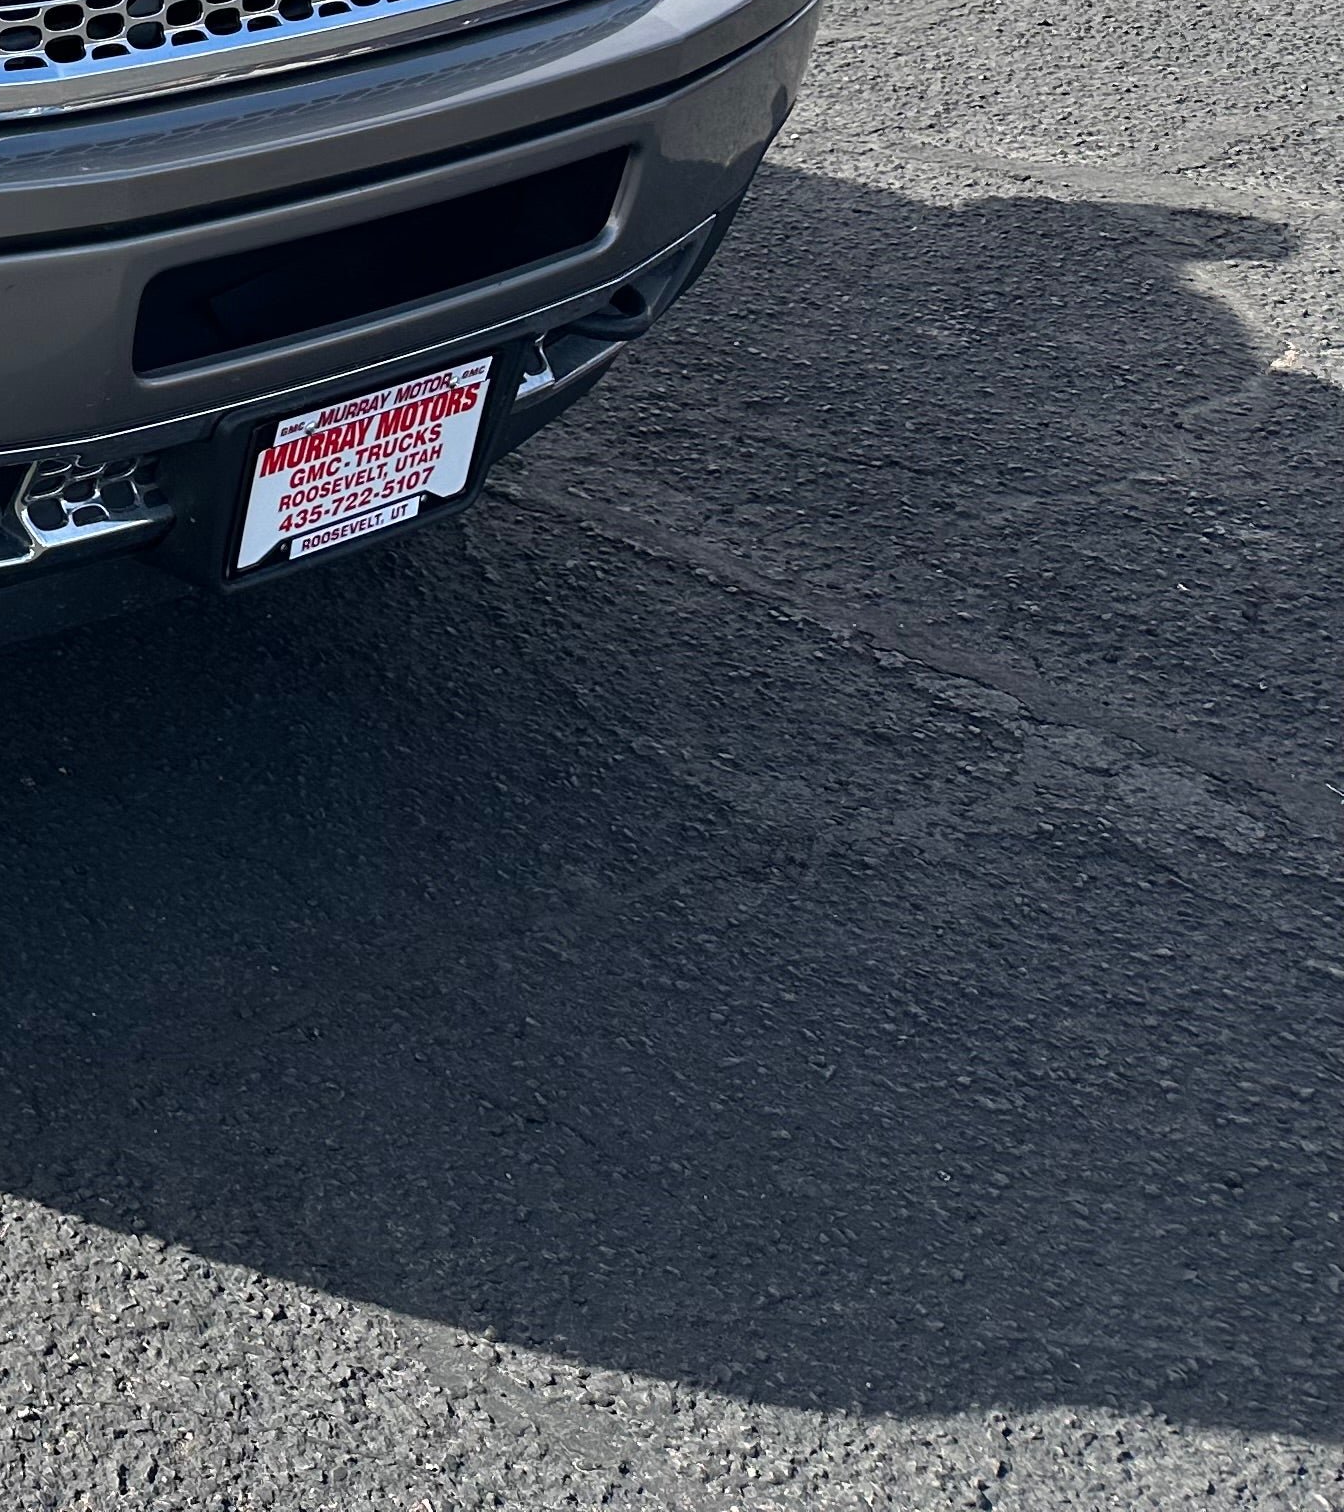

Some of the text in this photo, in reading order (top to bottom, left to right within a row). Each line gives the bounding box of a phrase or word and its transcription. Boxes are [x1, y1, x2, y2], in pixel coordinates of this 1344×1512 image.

[259, 382, 480, 478] MURRAY MOTORS
[280, 421, 305, 437] GMC
[316, 390, 392, 429] MURRAY
[461, 365, 486, 379] GMC
[278, 443, 443, 513] ROOSEVELT, UTAH
[279, 466, 435, 533] 435-722-5107
[391, 504, 408, 520] UT
